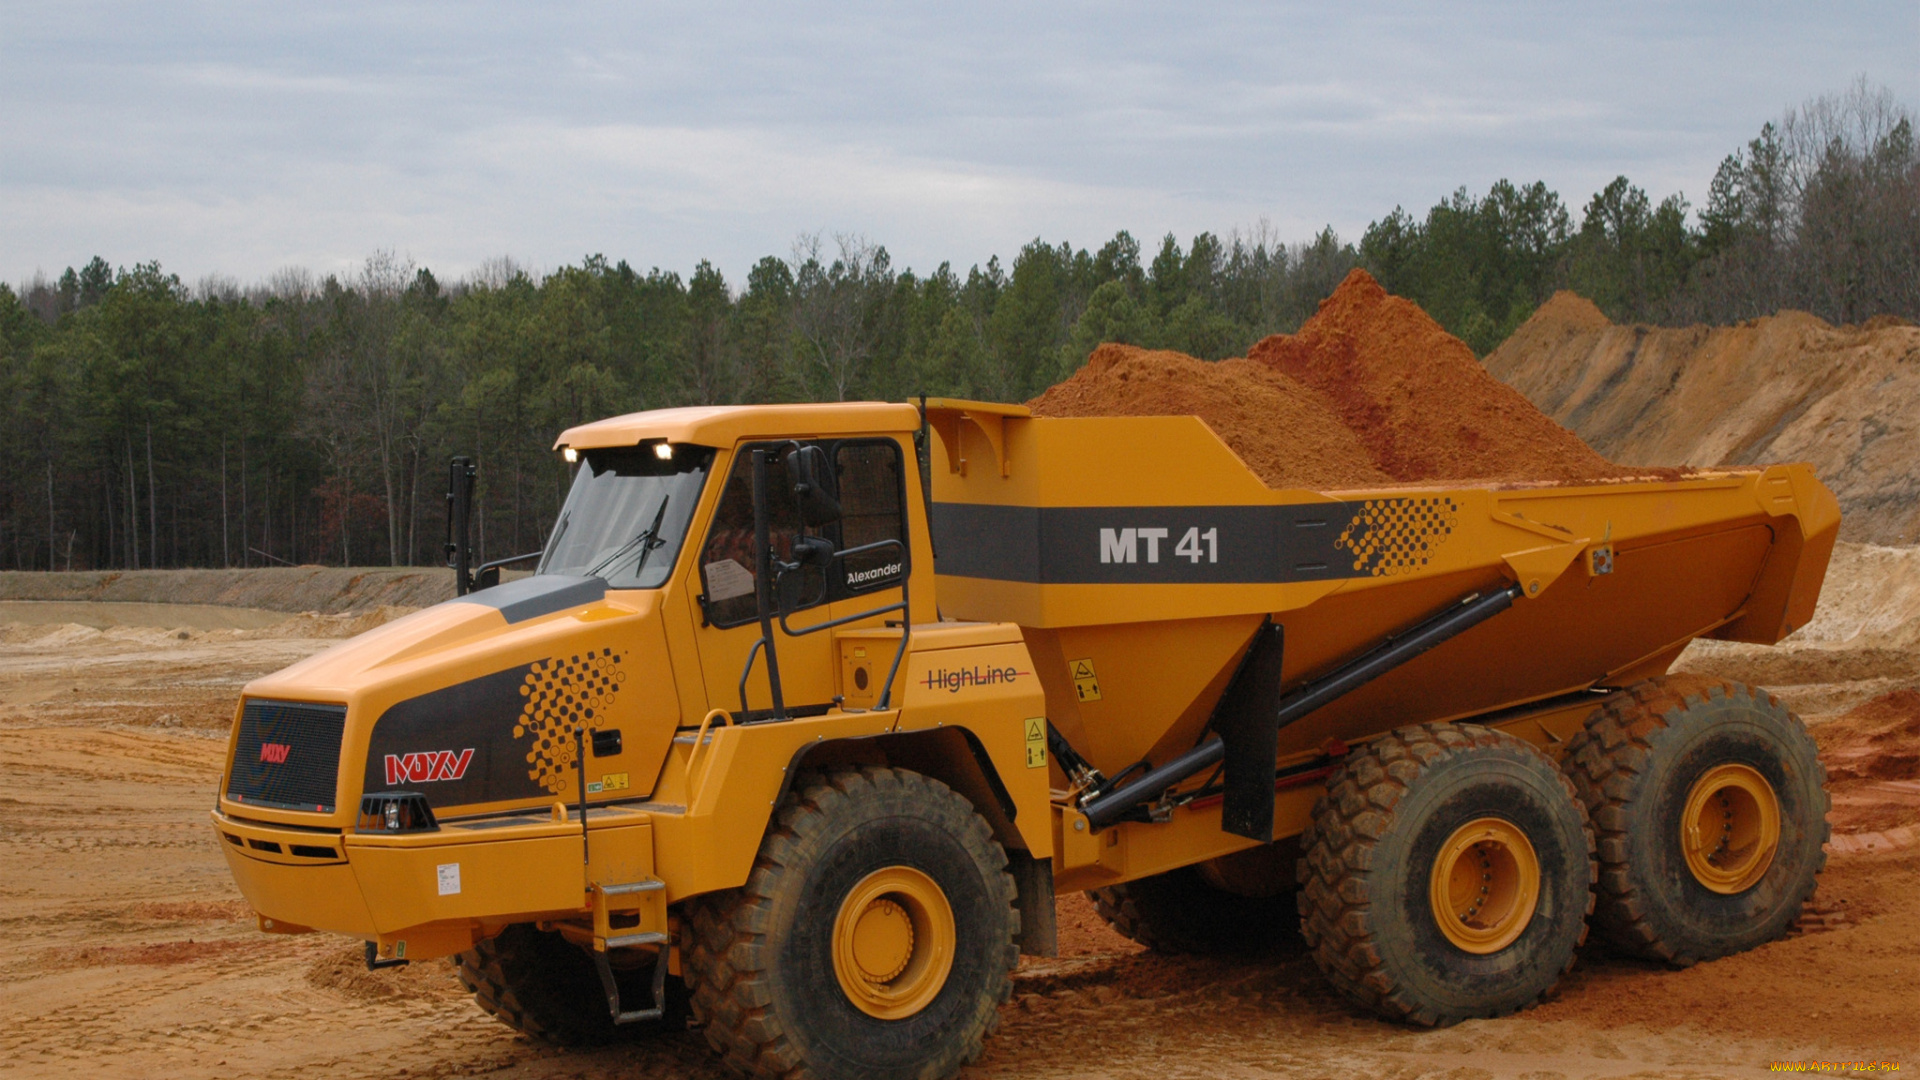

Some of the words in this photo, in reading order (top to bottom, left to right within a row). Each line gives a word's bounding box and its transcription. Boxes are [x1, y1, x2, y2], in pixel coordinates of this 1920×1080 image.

[1100, 527, 1168, 563] MT
[1175, 526, 1218, 563] 41
[847, 562, 902, 585] Alexander
[927, 665, 1017, 693] HighLine
[384, 748, 475, 785] MOXY
